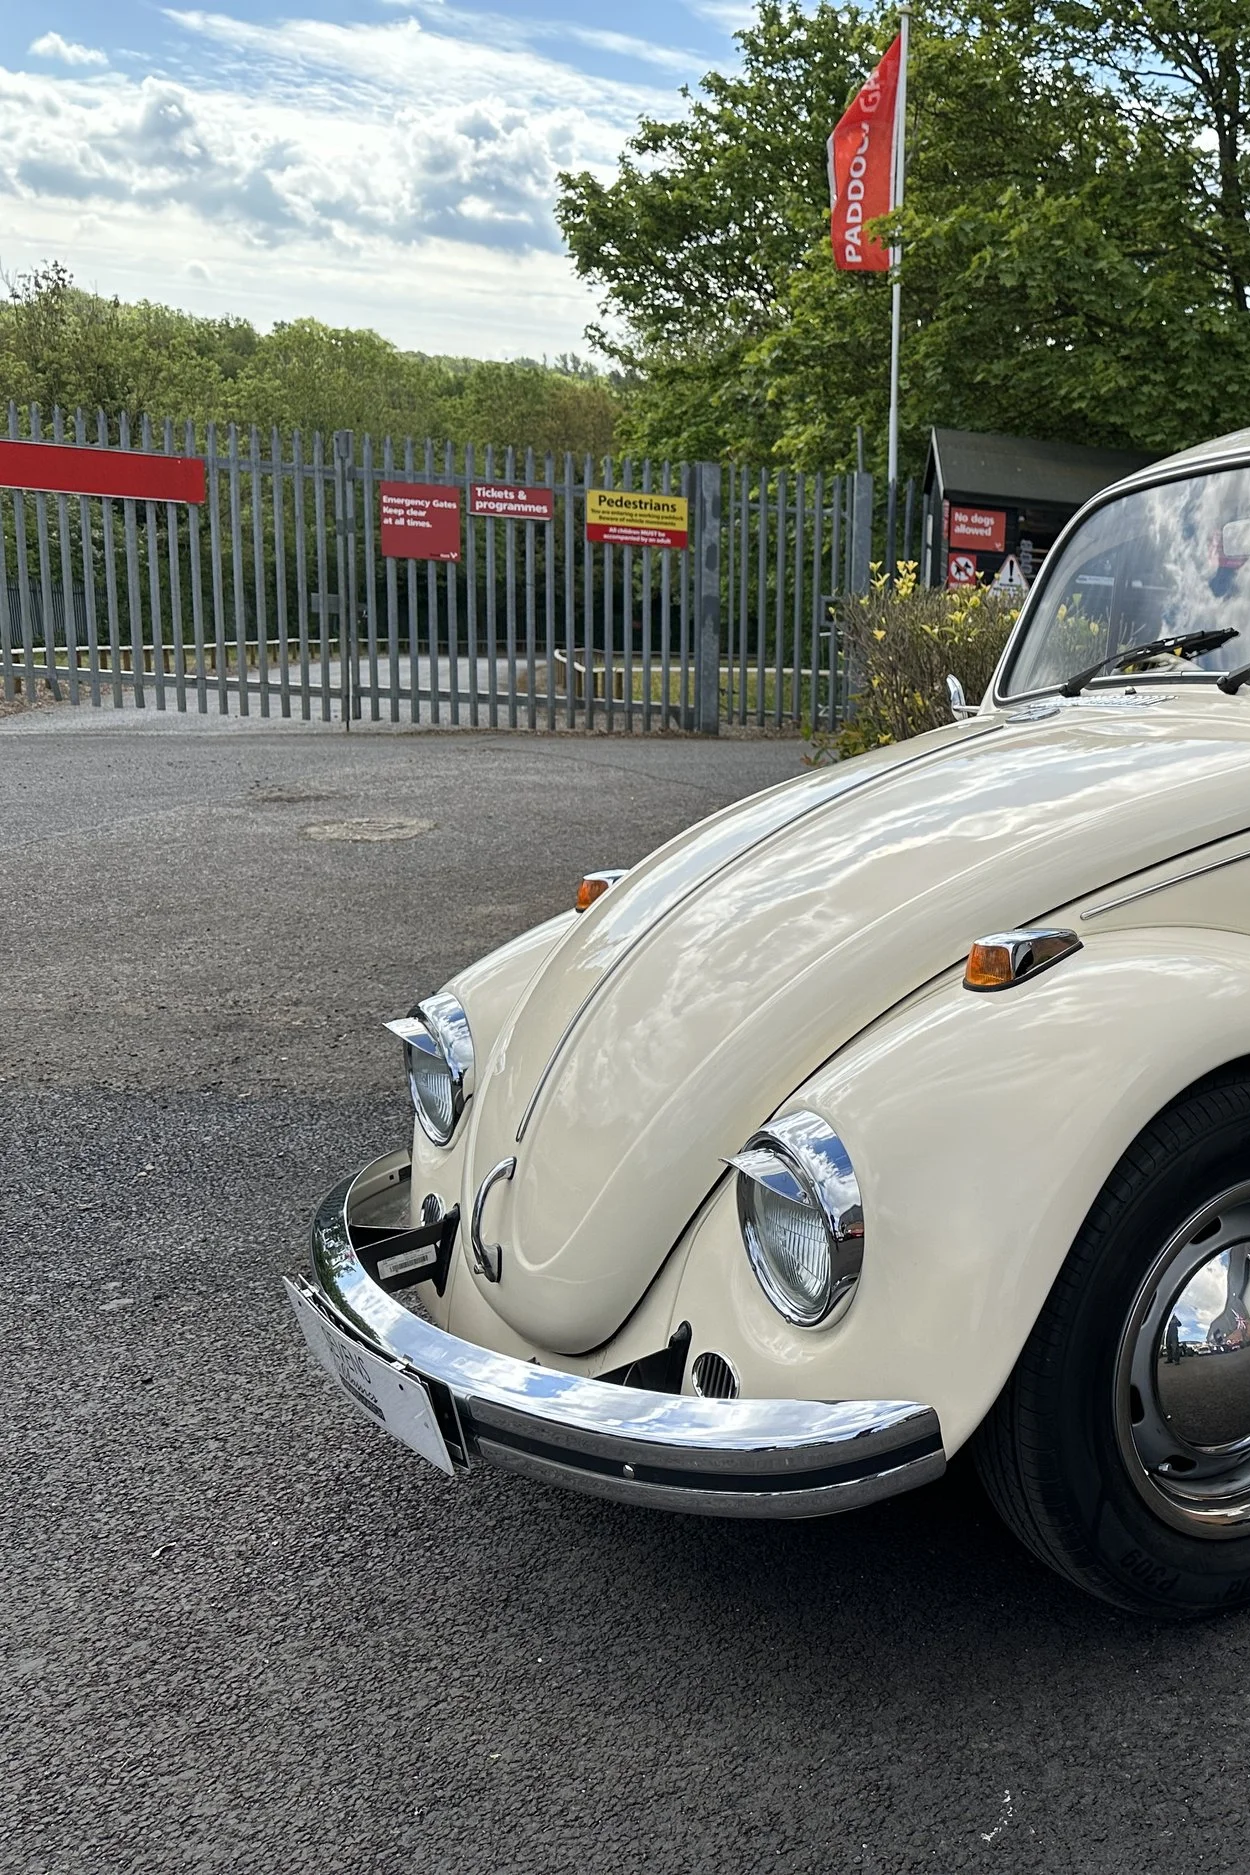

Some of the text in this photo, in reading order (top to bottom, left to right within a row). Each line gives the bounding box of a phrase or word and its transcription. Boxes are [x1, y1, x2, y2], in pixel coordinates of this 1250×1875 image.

[845, 121, 870, 263] PADDO
[475, 486, 527, 500] Tickets &
[382, 495, 457, 509] Emergency Gates
[475, 500, 548, 513] programmes
[598, 494, 677, 512] Pedestrians
[382, 506, 427, 516] Keep clear
[383, 517, 432, 528] at all times.
[954, 511, 995, 527] No dogs
[954, 523, 992, 536] allowed
[1119, 1549, 1182, 1592] P309
